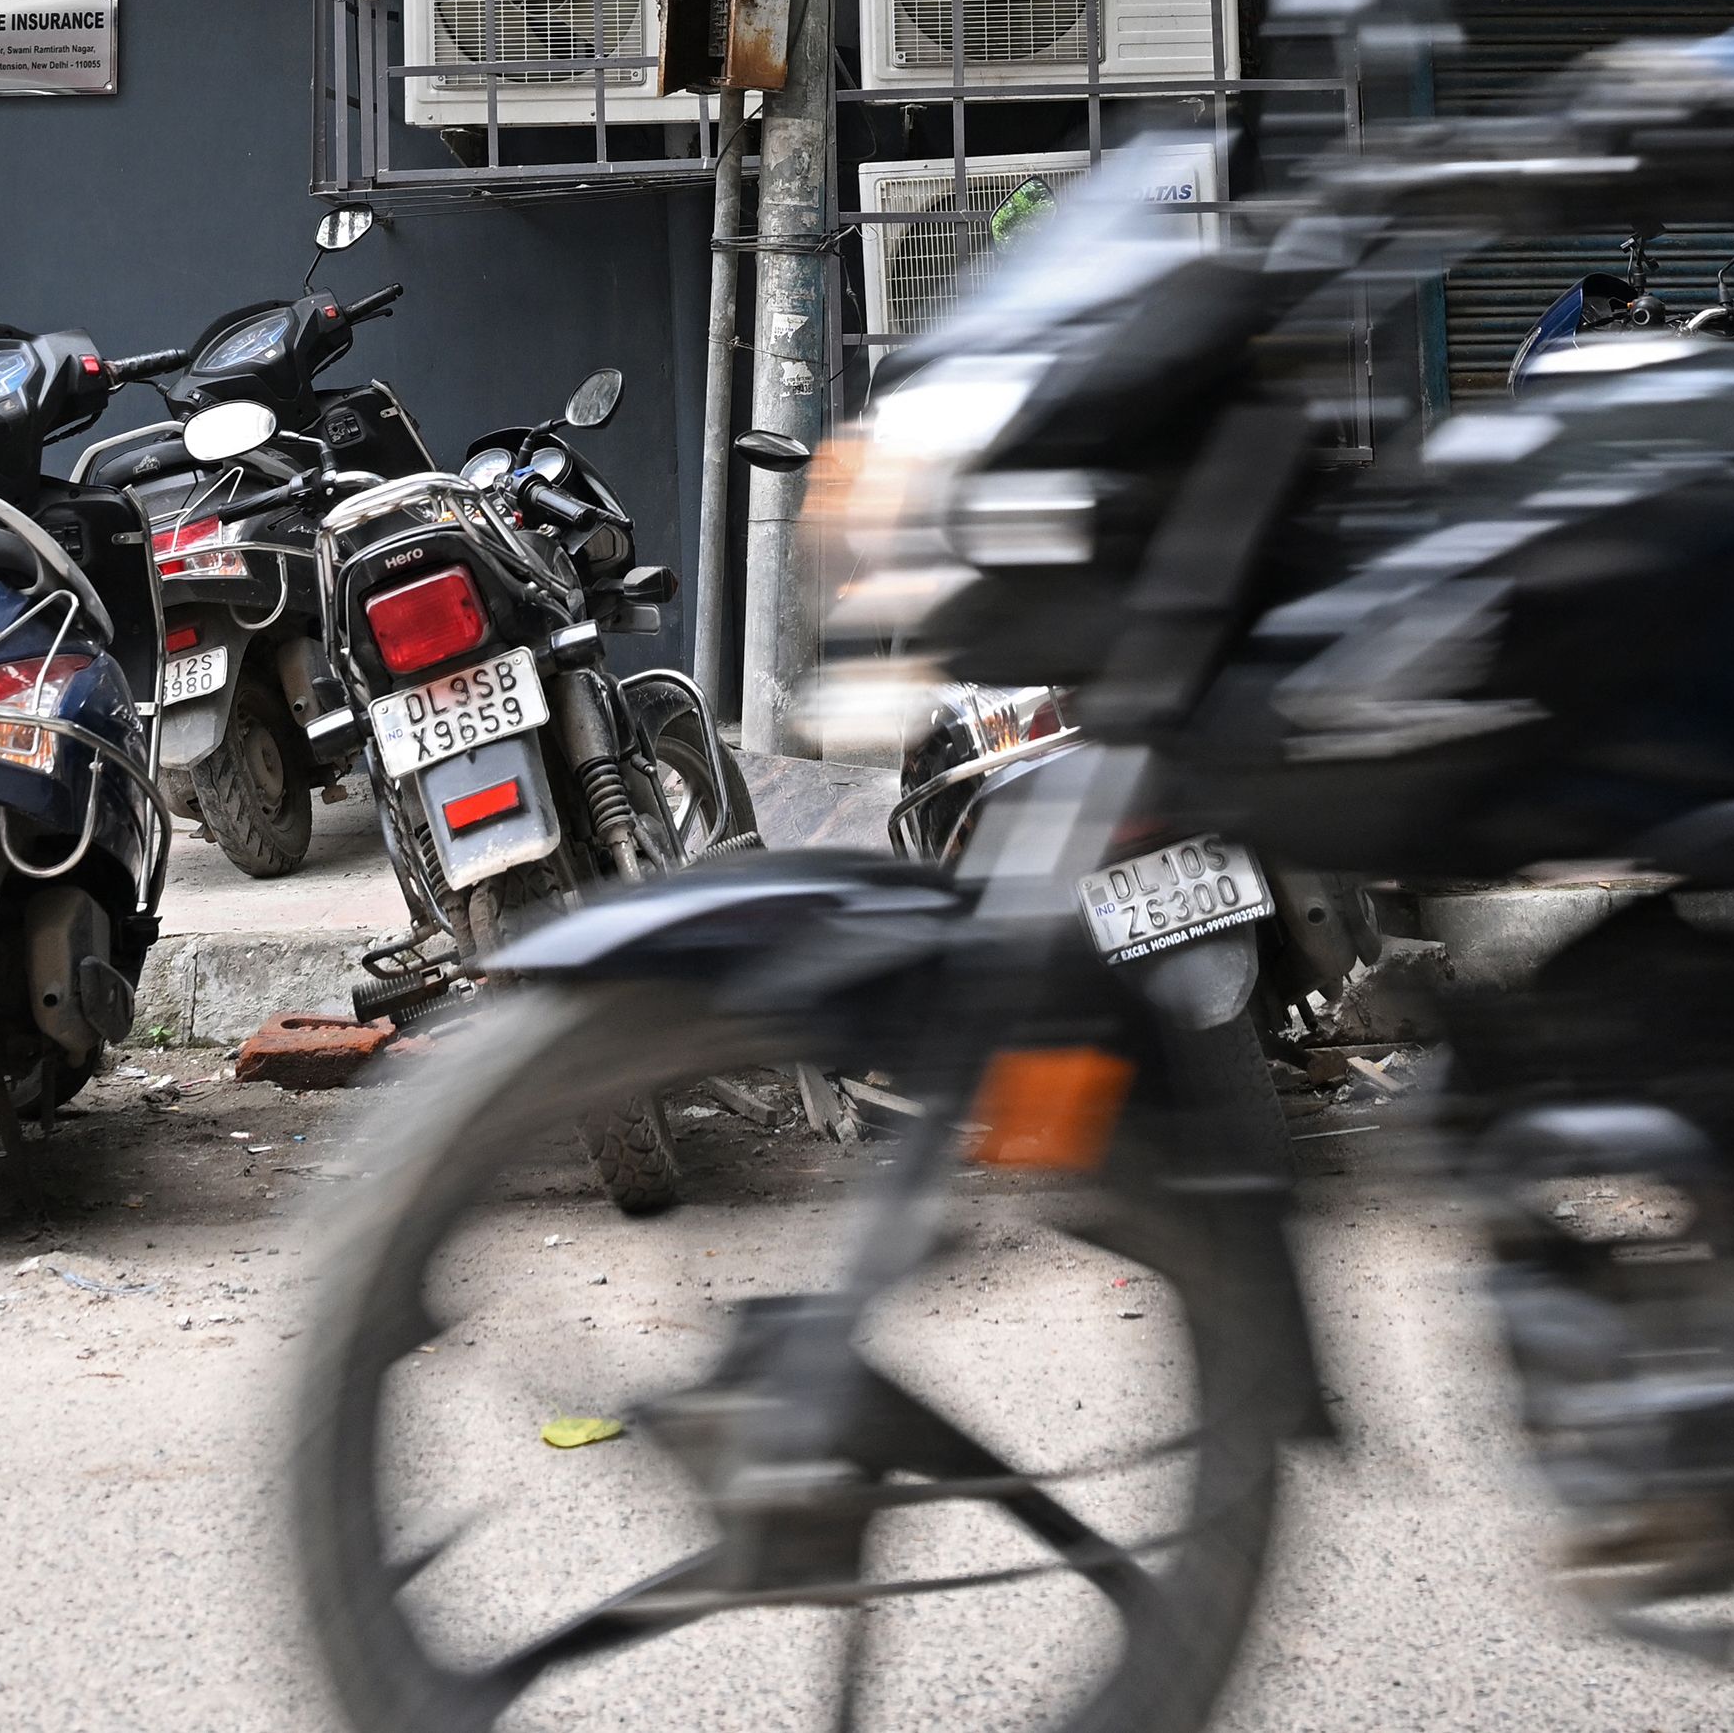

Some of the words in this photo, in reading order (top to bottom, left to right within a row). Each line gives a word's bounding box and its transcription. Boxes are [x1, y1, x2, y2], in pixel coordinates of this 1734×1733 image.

[11, 12, 105, 31] INSURANCE
[7, 45, 32, 54] Swami
[33, 45, 70, 54] Ramtirath
[72, 44, 96, 55] Nagar,
[31, 62, 48, 70] New
[50, 60, 69, 69] Delhi
[76, 60, 101, 69] 110055
[384, 547, 424, 569] Hero
[404, 662, 517, 726] DL9SB
[384, 730, 404, 742] IND
[412, 697, 523, 761] X9659
[1095, 902, 1116, 917] IND
[1121, 874, 1239, 940] Z6300
[1120, 943, 1151, 962] EXCEL
[1150, 931, 1189, 953] HONDA
